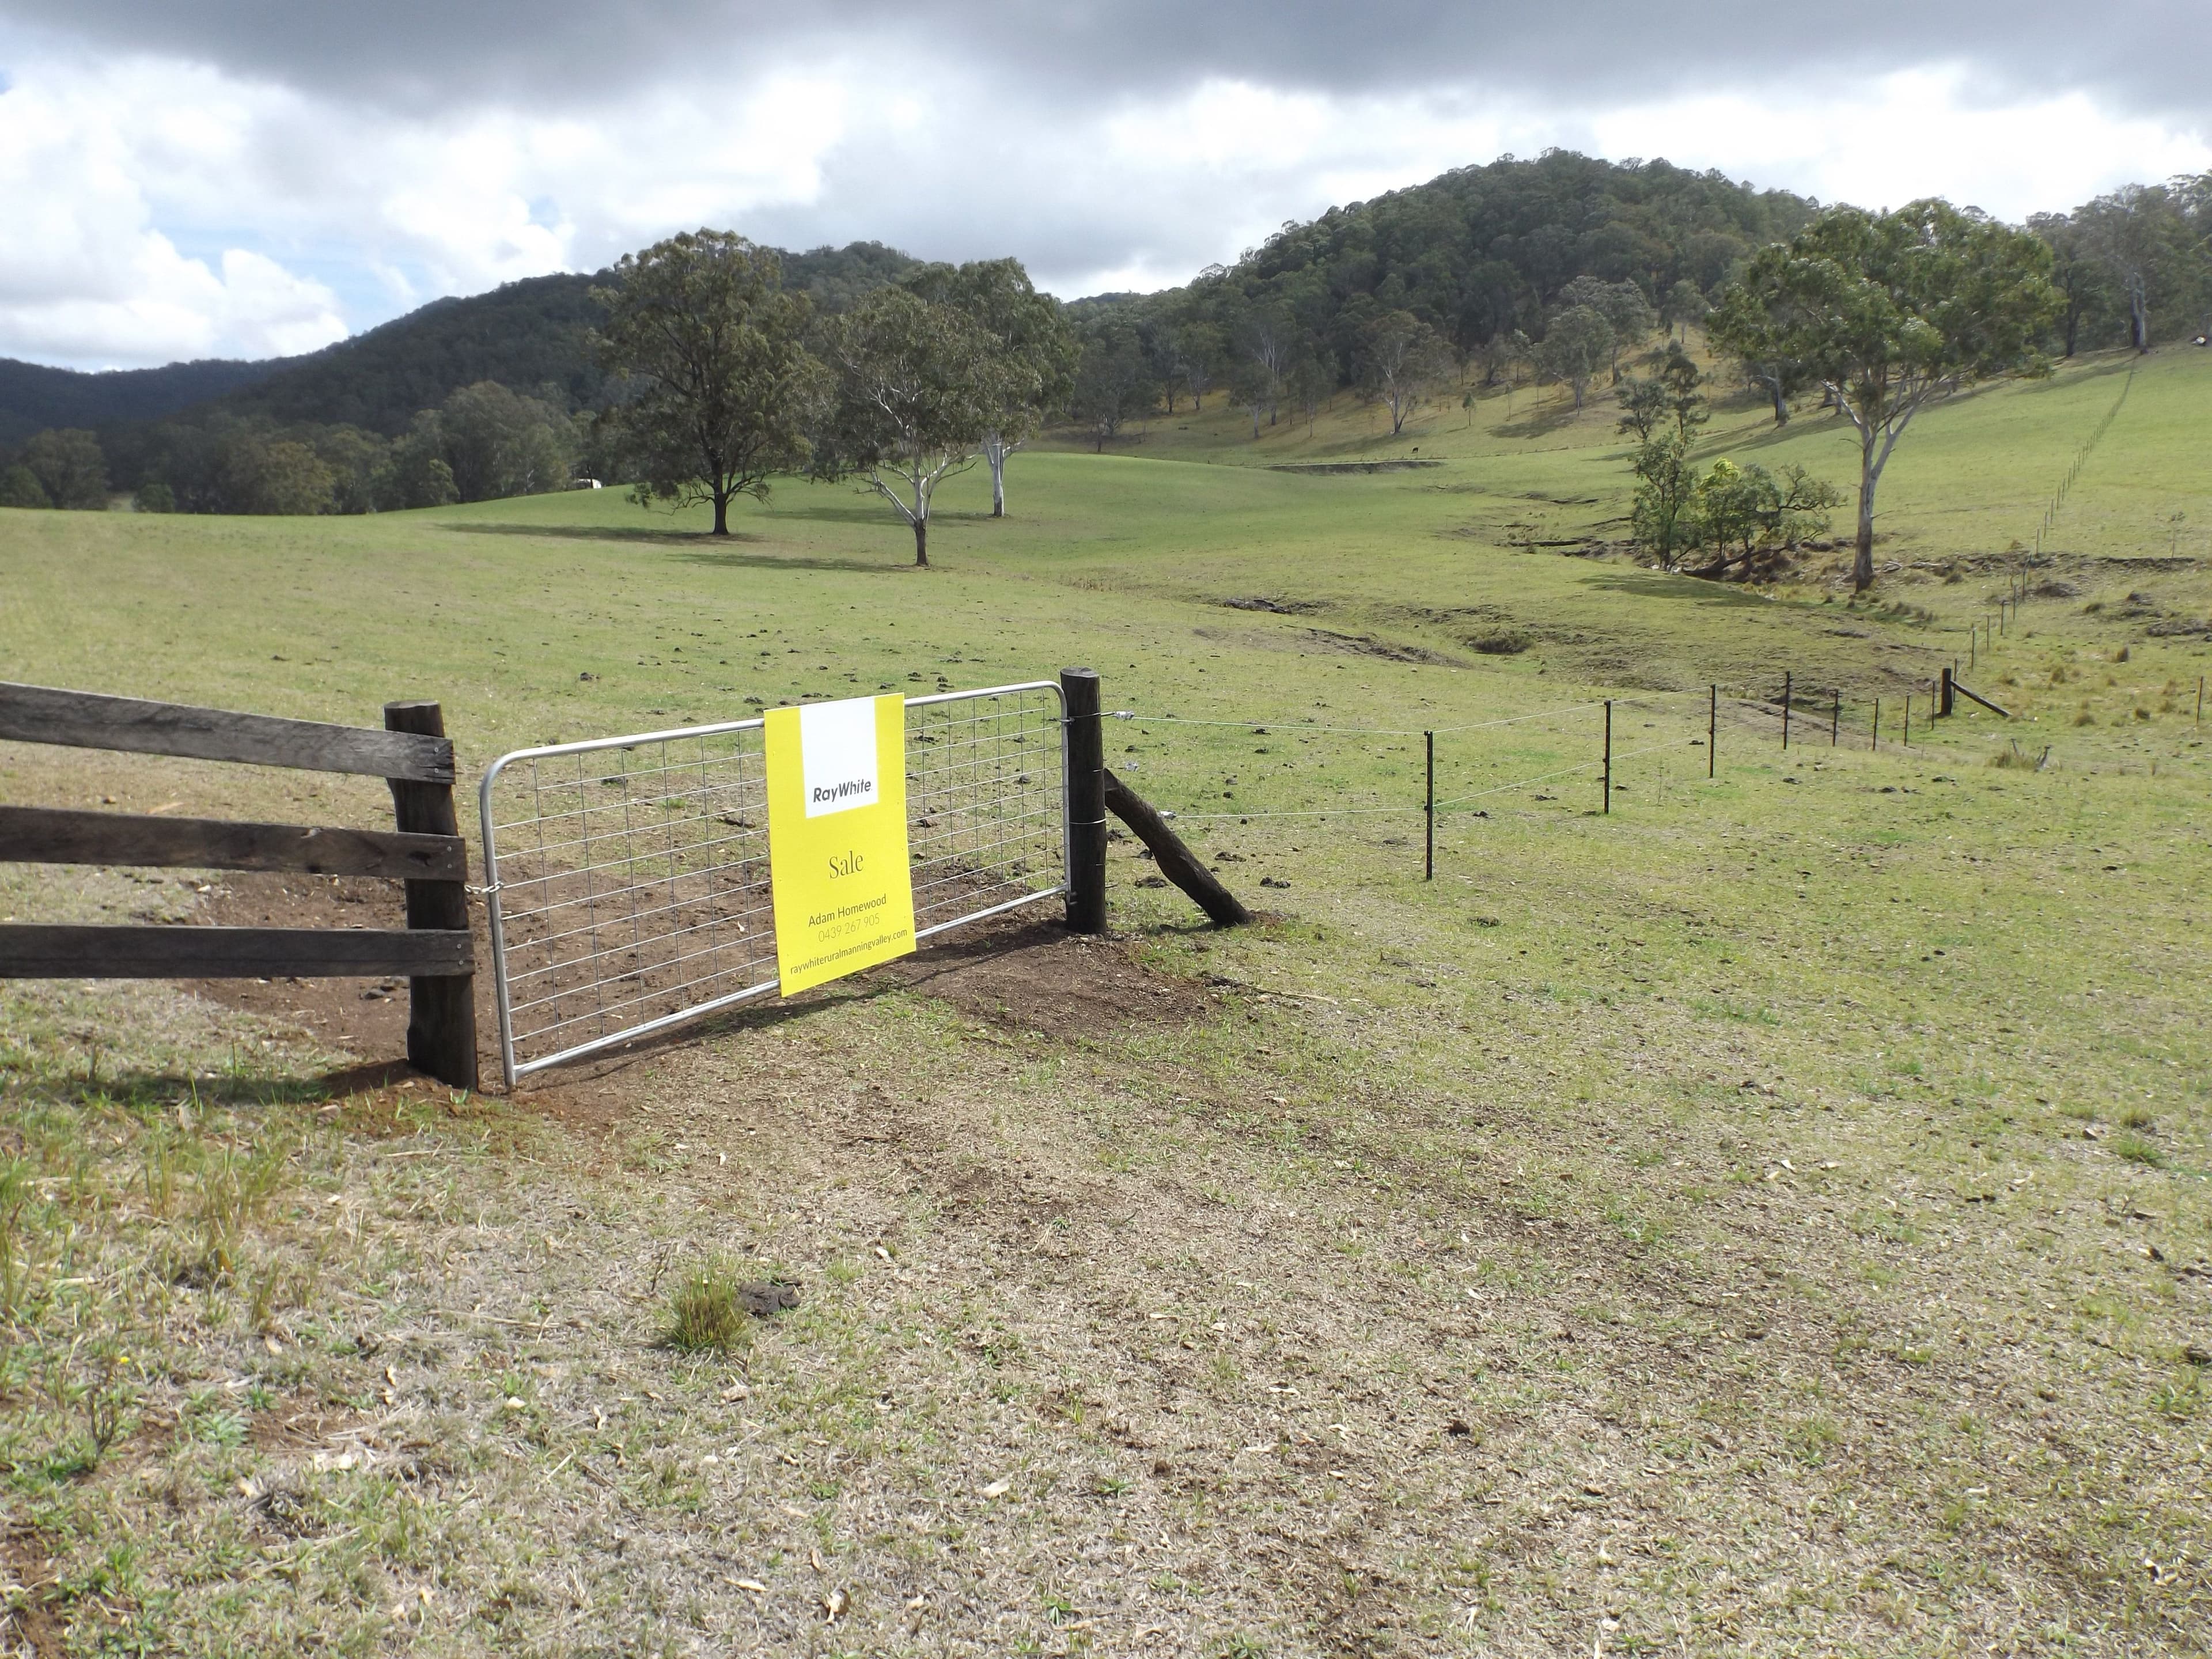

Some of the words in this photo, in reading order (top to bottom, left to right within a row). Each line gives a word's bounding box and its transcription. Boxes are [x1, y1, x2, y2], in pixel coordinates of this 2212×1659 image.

[813, 778, 872, 802] RayWhite
[829, 850, 864, 879] Sale
[808, 912, 835, 927] Adam
[838, 893, 887, 919] Homewood
[818, 925, 842, 942] 0439
[845, 919, 861, 935] 267
[863, 912, 880, 928] 905
[790, 929, 908, 975] raywhiteruralmanningvalley.com
